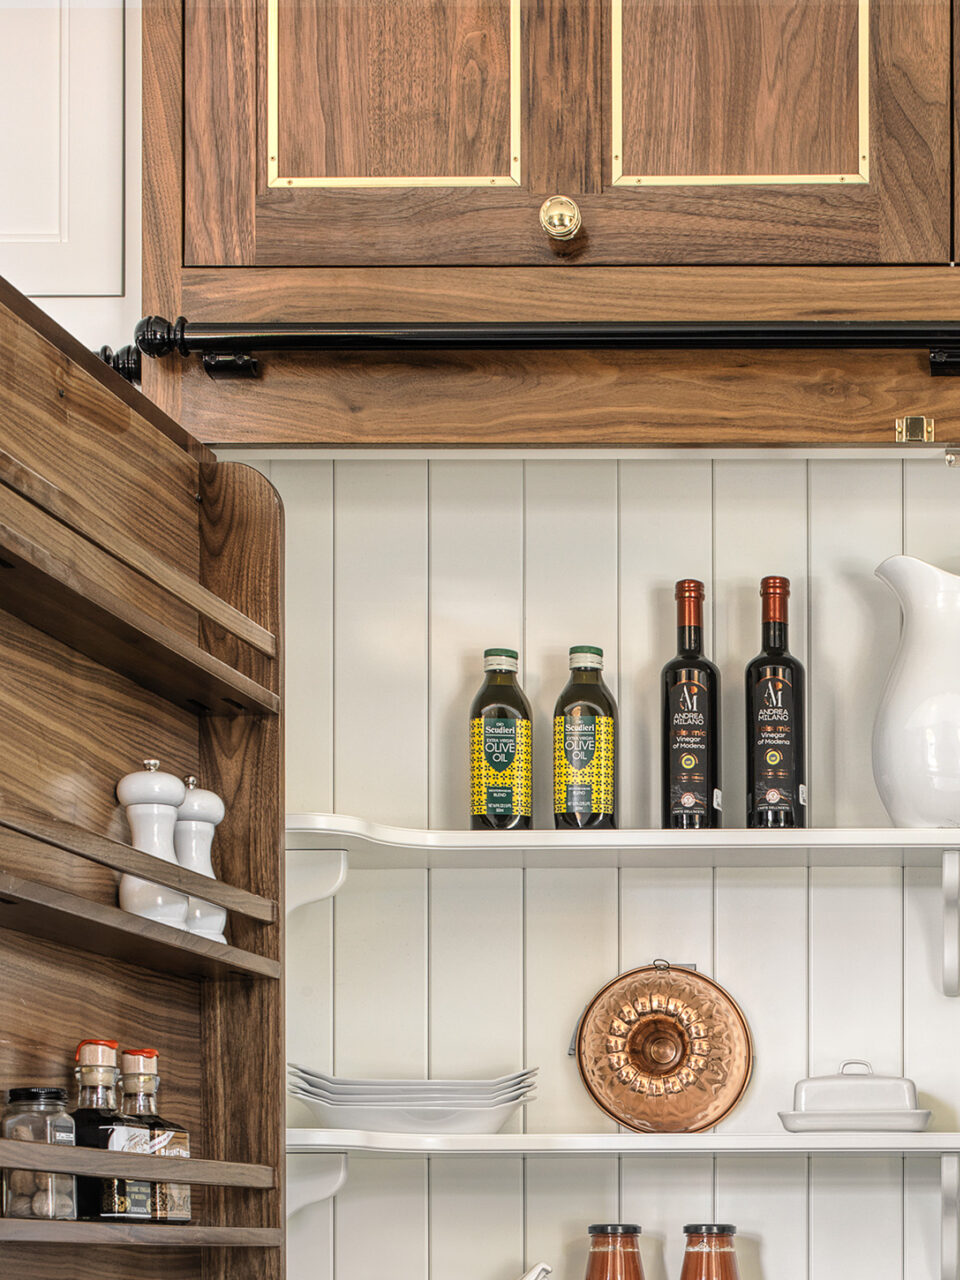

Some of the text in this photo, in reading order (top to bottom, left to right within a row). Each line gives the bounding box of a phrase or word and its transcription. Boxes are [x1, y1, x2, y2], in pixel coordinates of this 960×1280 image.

[485, 726, 515, 734] Scudieri
[565, 724, 594, 732] Scudieri
[485, 743, 515, 753] OLIVE
[565, 741, 594, 751] OLIVE
[492, 753, 508, 762] OIL
[572, 751, 587, 760] OIL
